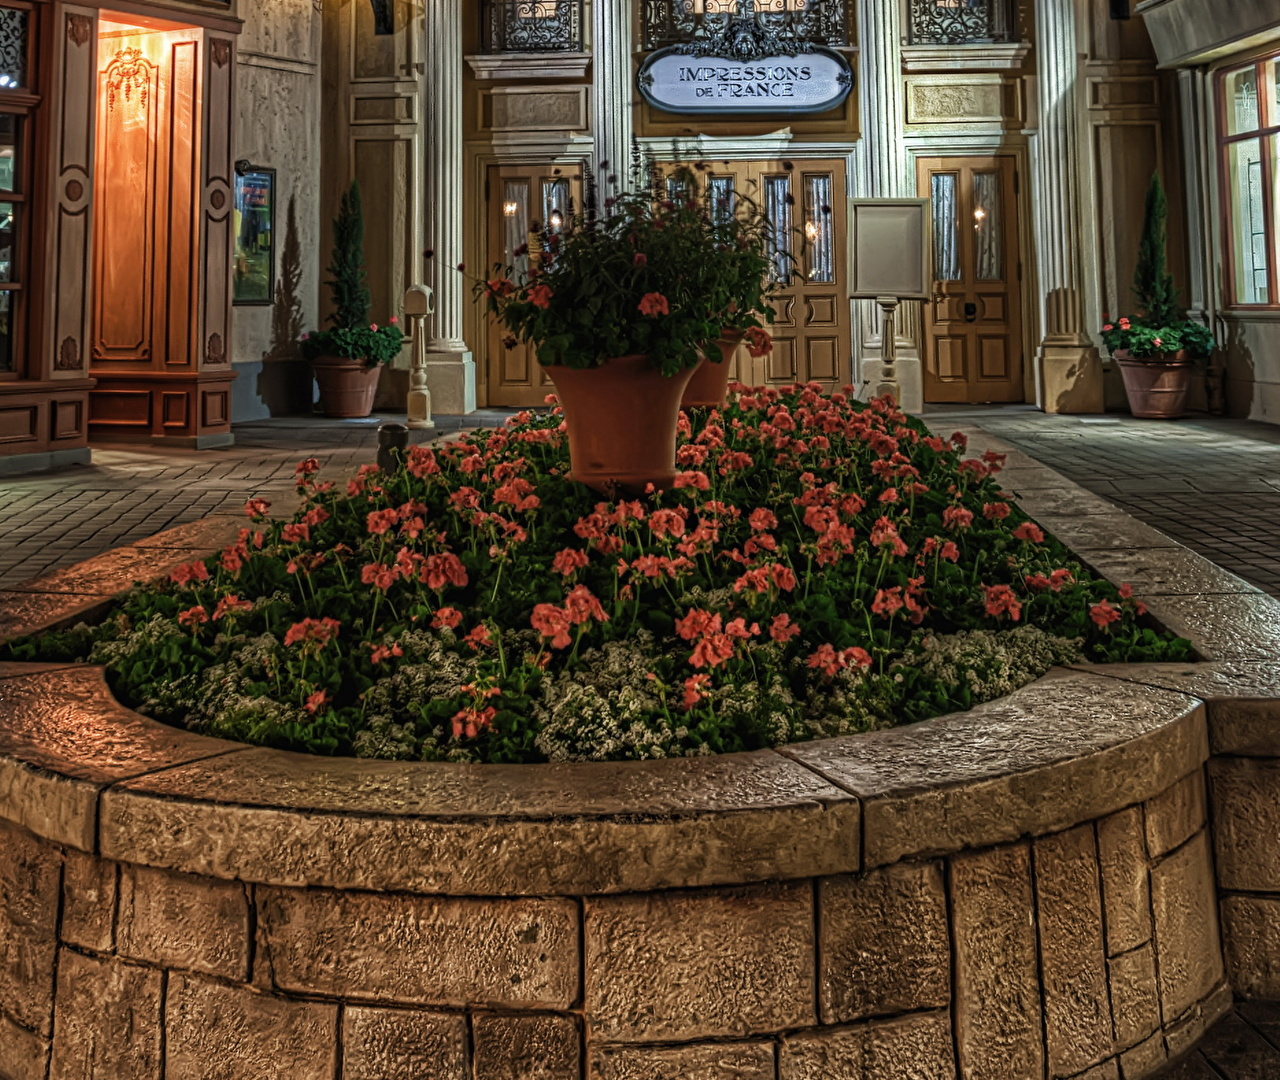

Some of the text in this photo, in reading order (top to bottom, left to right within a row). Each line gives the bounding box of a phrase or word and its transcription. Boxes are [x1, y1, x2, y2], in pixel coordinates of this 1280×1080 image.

[679, 66, 812, 82] IMPRESSIONS
[696, 82, 794, 98] DE FRANCE
